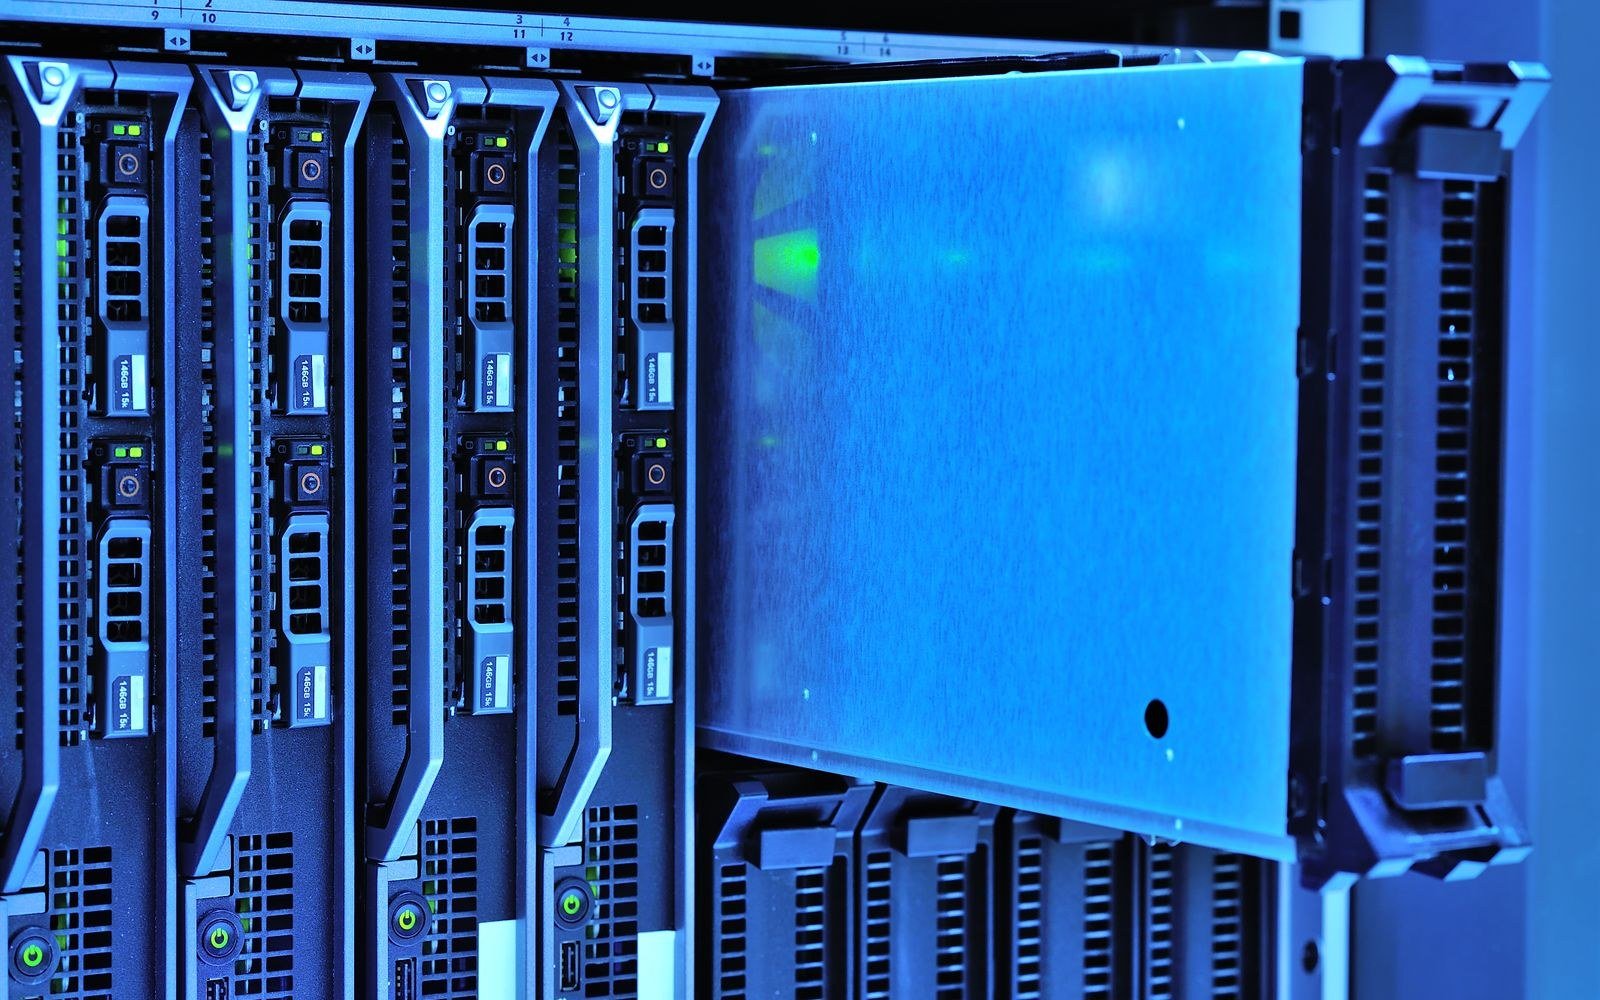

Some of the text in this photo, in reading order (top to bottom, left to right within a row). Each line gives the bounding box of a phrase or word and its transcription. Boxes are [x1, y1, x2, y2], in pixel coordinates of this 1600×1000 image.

[151, 10, 160, 21] 9
[202, 13, 217, 24] 10
[516, 14, 523, 25] 3
[563, 17, 571, 27] 4
[513, 29, 526, 39] 11
[560, 31, 573, 42] 12
[120, 359, 129, 389] 146GB
[301, 360, 309, 388] 146GB
[486, 359, 494, 387] 146GB
[303, 670, 312, 699] 146GB
[485, 661, 493, 689] 146GB
[119, 680, 128, 710] 146GB
